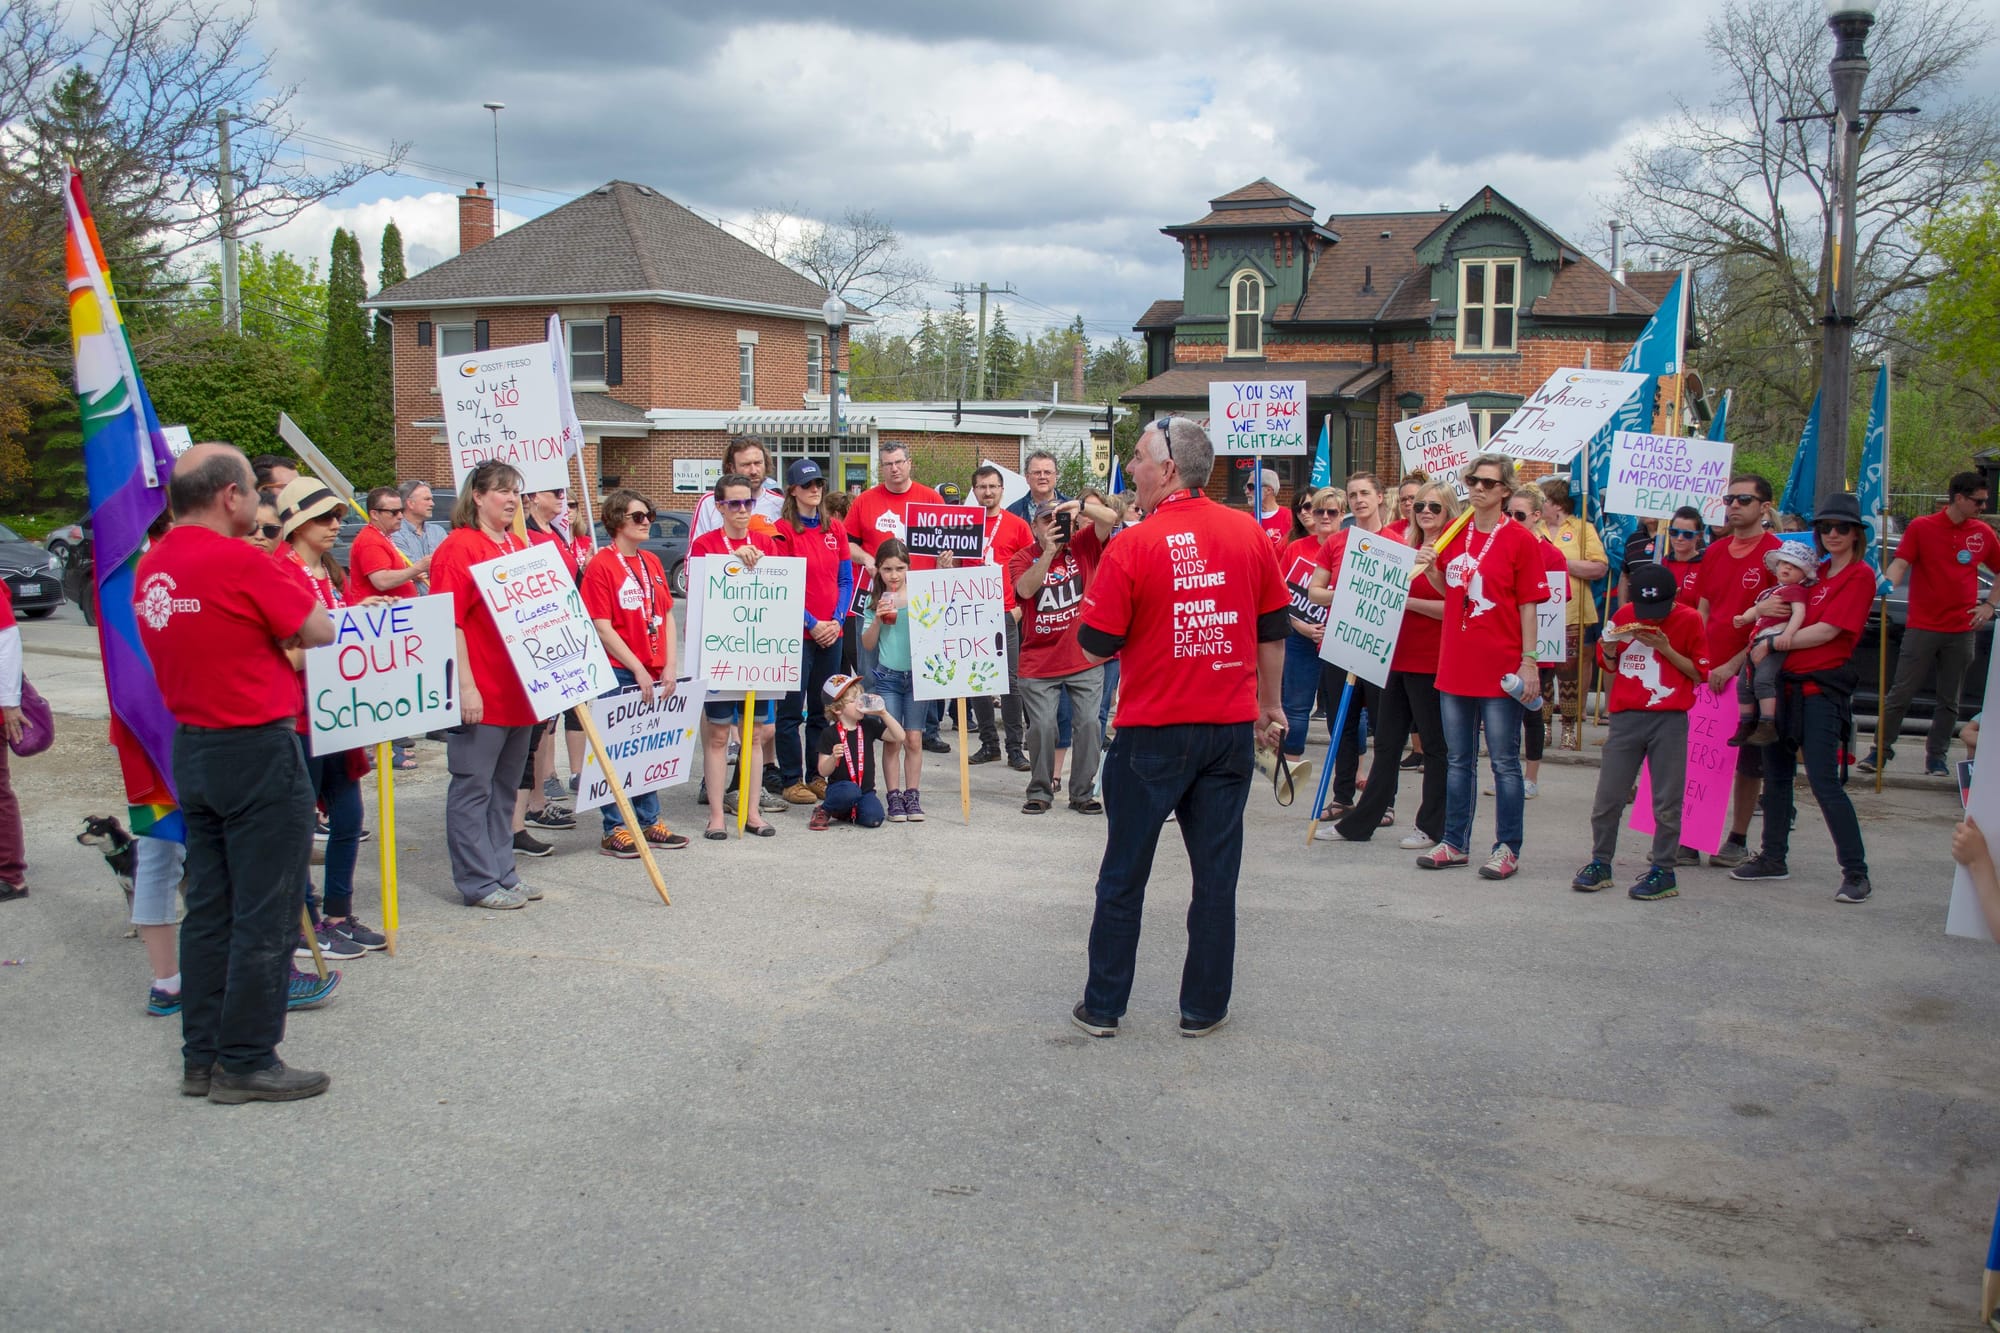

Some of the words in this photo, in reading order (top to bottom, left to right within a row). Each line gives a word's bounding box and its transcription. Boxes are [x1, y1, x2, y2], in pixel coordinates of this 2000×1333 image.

[475, 374, 517, 394] Just
[1233, 384, 1262, 401] YOU
[1269, 384, 1294, 400] SAY
[457, 399, 481, 418] say
[494, 388, 519, 407] NO
[1226, 402, 1260, 419] CUT
[1266, 401, 1301, 417] BACK
[480, 408, 503, 426] to
[1232, 419, 1255, 432] WE
[1266, 418, 1291, 431] SAY
[1513, 406, 1555, 432] The
[458, 427, 491, 447] Cuts
[501, 424, 517, 440] to
[1406, 430, 1437, 450] CUTS
[1442, 419, 1471, 441] MEAN
[1623, 434, 1687, 456] LARGER
[461, 436, 563, 468] EDUCATION
[1423, 440, 1453, 460] MORE
[1236, 458, 1255, 469] OPE
[1630, 453, 1693, 473] CLASSES
[1698, 461, 1724, 477] AN
[917, 512, 937, 527] NO
[940, 513, 974, 530] CUTS
[911, 532, 978, 550] EDUCATION
[1166, 532, 1196, 547] FOR
[1170, 546, 1198, 561] OUR
[1174, 572, 1226, 591] FUTURE
[1350, 551, 1379, 577] THIS
[1383, 564, 1409, 592] WILL
[487, 569, 567, 612] LARGER
[709, 575, 788, 600] Maintain
[931, 577, 1003, 603] HANDS
[1037, 578, 1083, 612] ALL
[944, 603, 984, 626] OFF
[1173, 600, 1216, 615] POUR
[1355, 598, 1386, 626] KIDS
[324, 605, 413, 647] AVE
[1174, 630, 1194, 644] DE
[1198, 626, 1224, 642] NOS
[705, 626, 800, 654] excellence
[1174, 640, 1232, 658] ENFANTS
[338, 635, 424, 681] OUR
[314, 658, 454, 731] Schools!
[607, 695, 688, 730] EDUCATION
[630, 722, 643, 736] IS
[646, 716, 660, 731] AN
[605, 728, 684, 761] NVESTMENT
[589, 778, 613, 800] NO
[623, 771, 632, 790] A
[644, 757, 680, 782] COST
